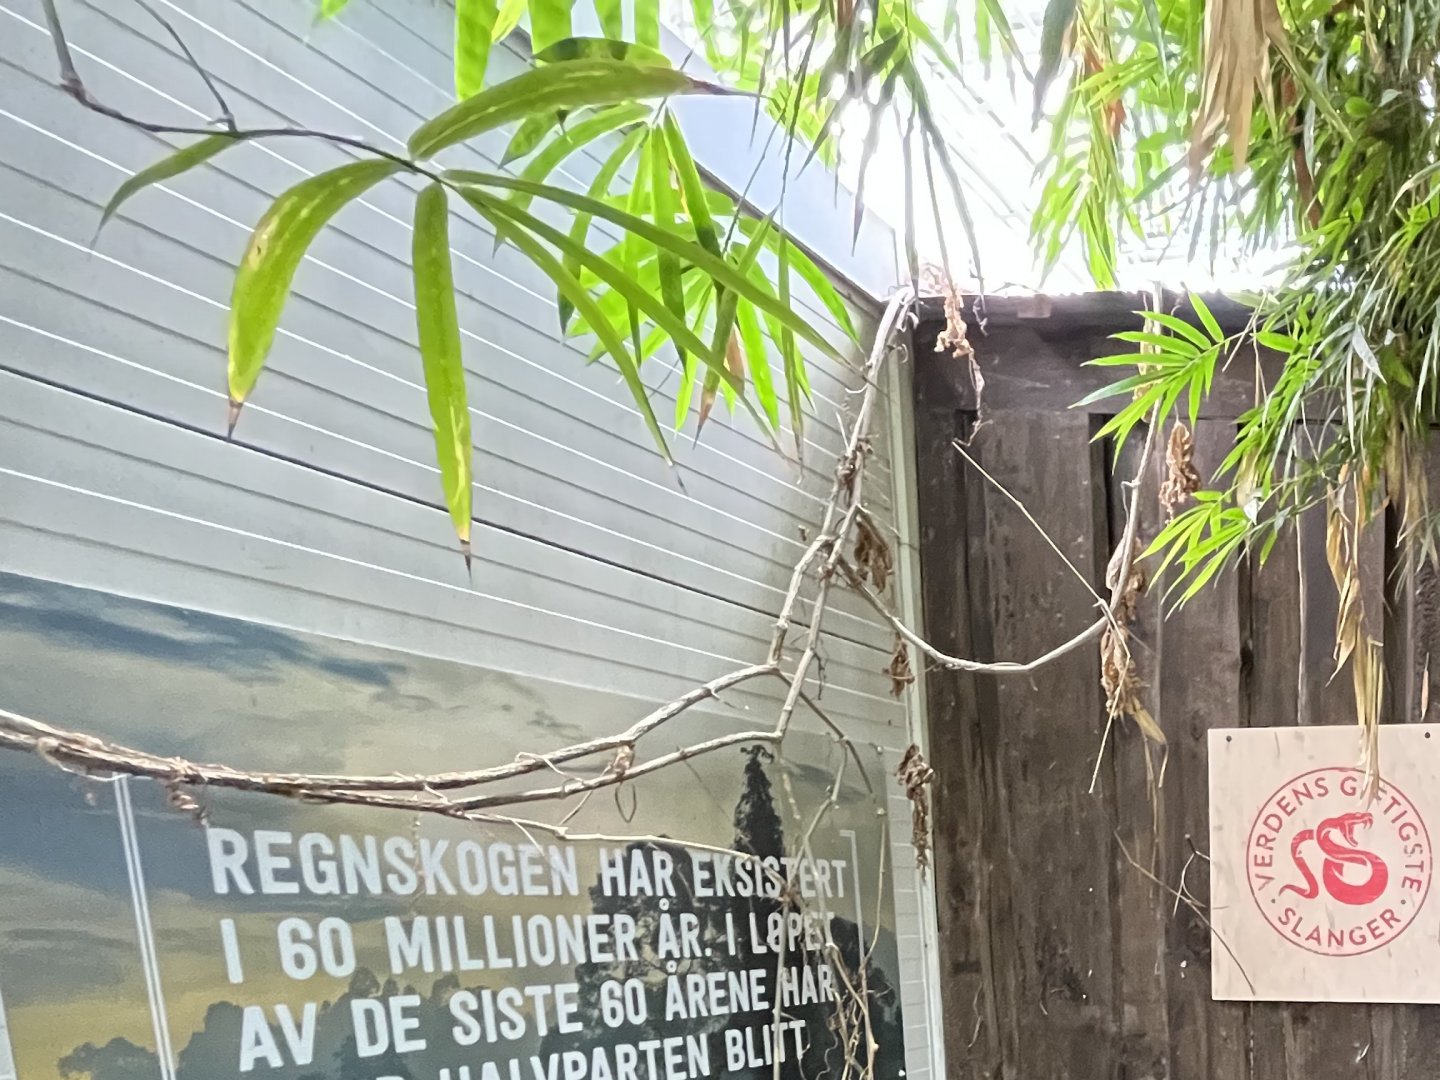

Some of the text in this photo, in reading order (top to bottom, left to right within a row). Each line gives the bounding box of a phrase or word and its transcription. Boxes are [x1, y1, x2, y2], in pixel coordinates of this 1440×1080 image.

[206, 827, 580, 897] REGNSKOGEN
[600, 846, 677, 898] HAR
[1253, 776, 1330, 892] VERDENS
[219, 917, 244, 985] I
[276, 916, 357, 981] 60
[384, 913, 639, 975] MILLIONER
[657, 897, 713, 960] ÅR.
[725, 911, 737, 957] I
[1277, 907, 1402, 948] SLANGER
[239, 959, 836, 1073] AV DE SISTE 60 ÅRENE HAR
[724, 1018, 807, 1073] BLITT
